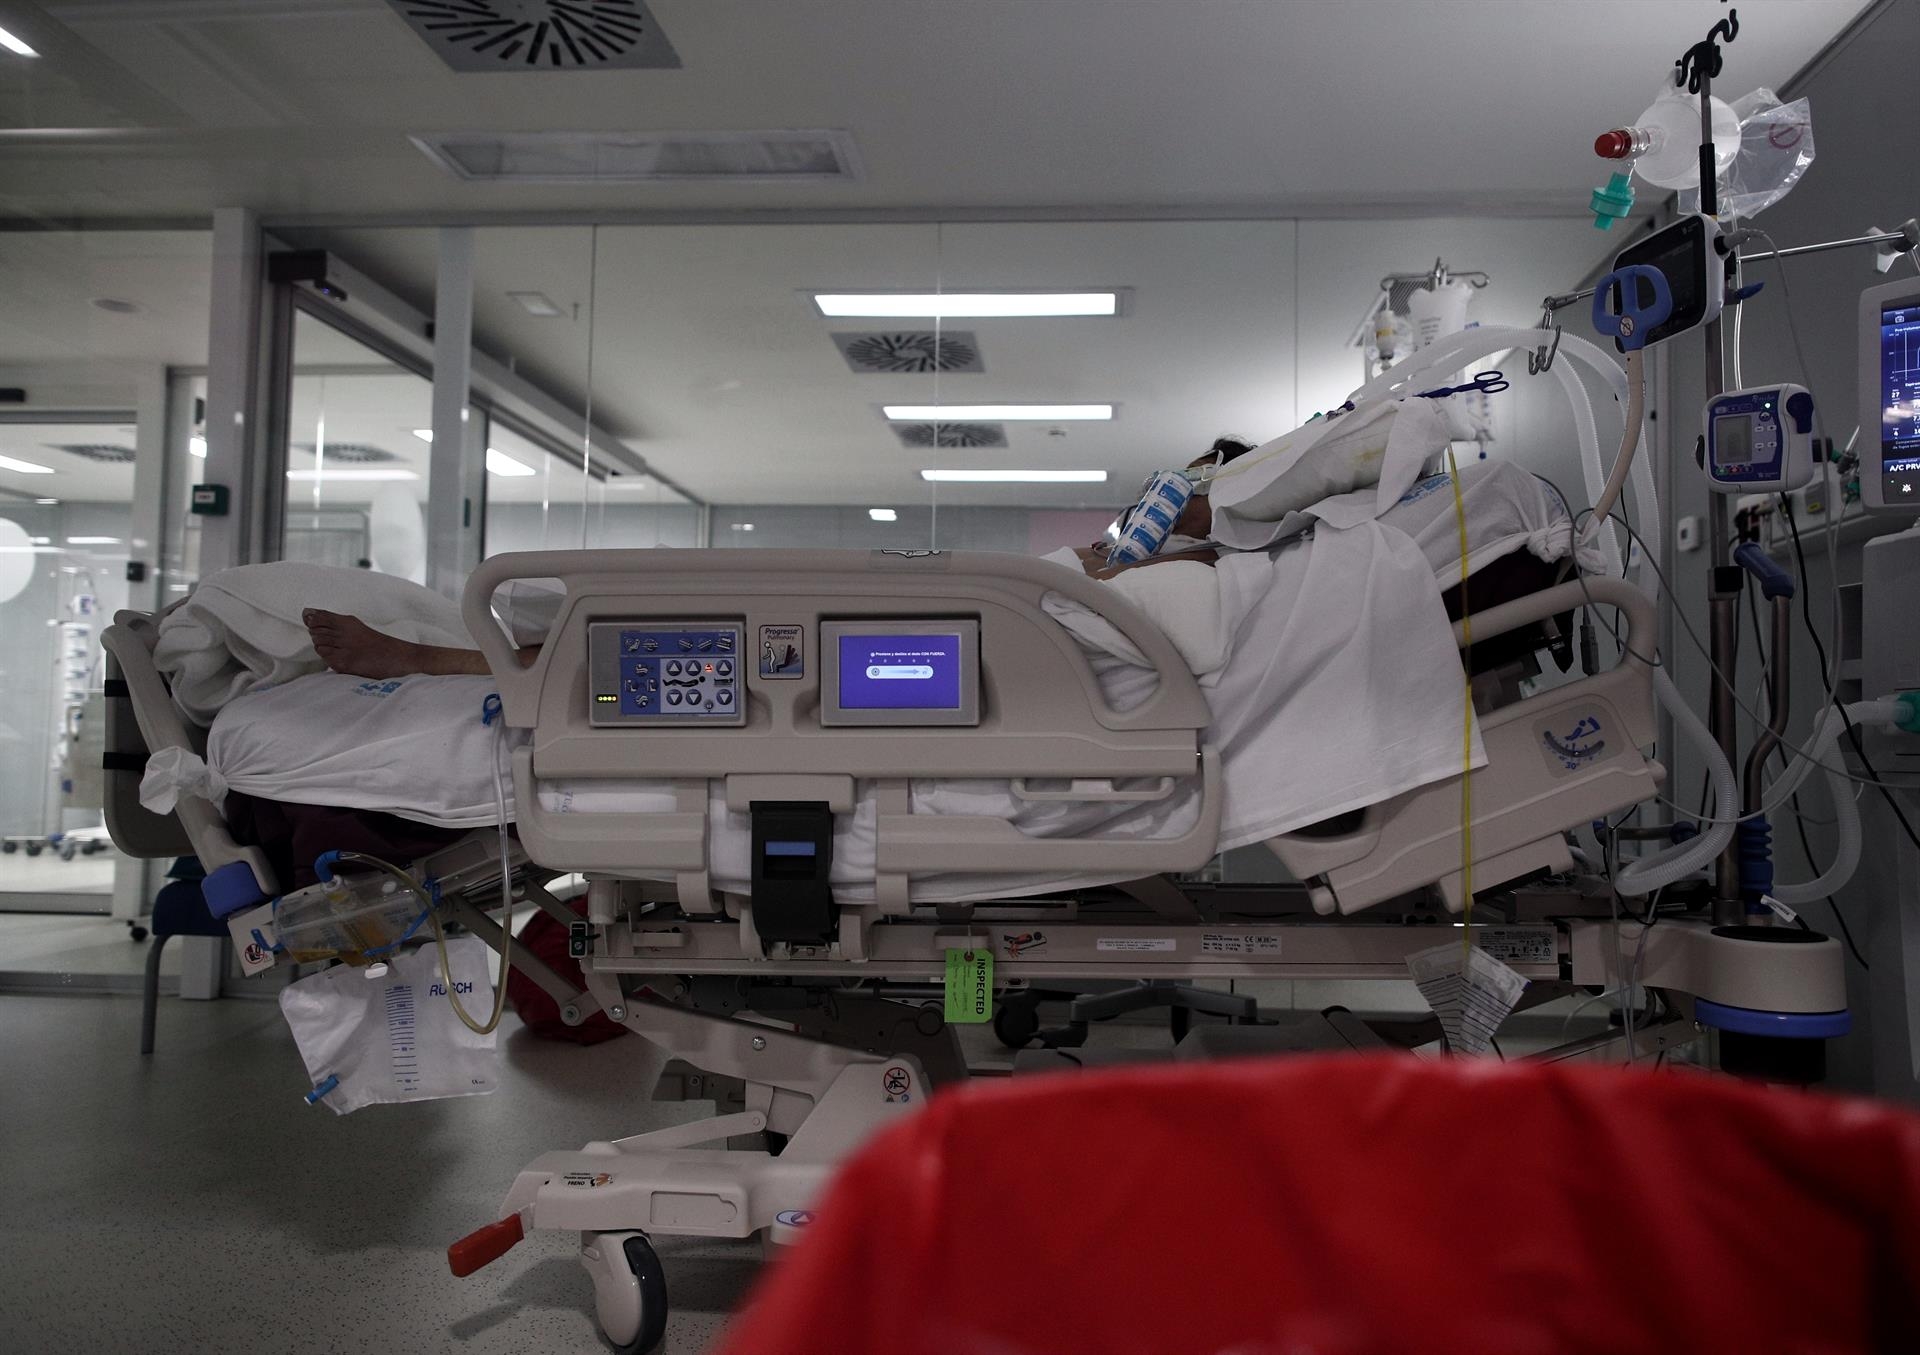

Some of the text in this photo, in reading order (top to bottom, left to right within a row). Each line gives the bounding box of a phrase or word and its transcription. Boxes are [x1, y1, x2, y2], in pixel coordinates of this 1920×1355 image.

[1889, 463, 1905, 473] A/C
[765, 627, 799, 636] Progressa
[976, 958, 986, 1015] INSPECTED
